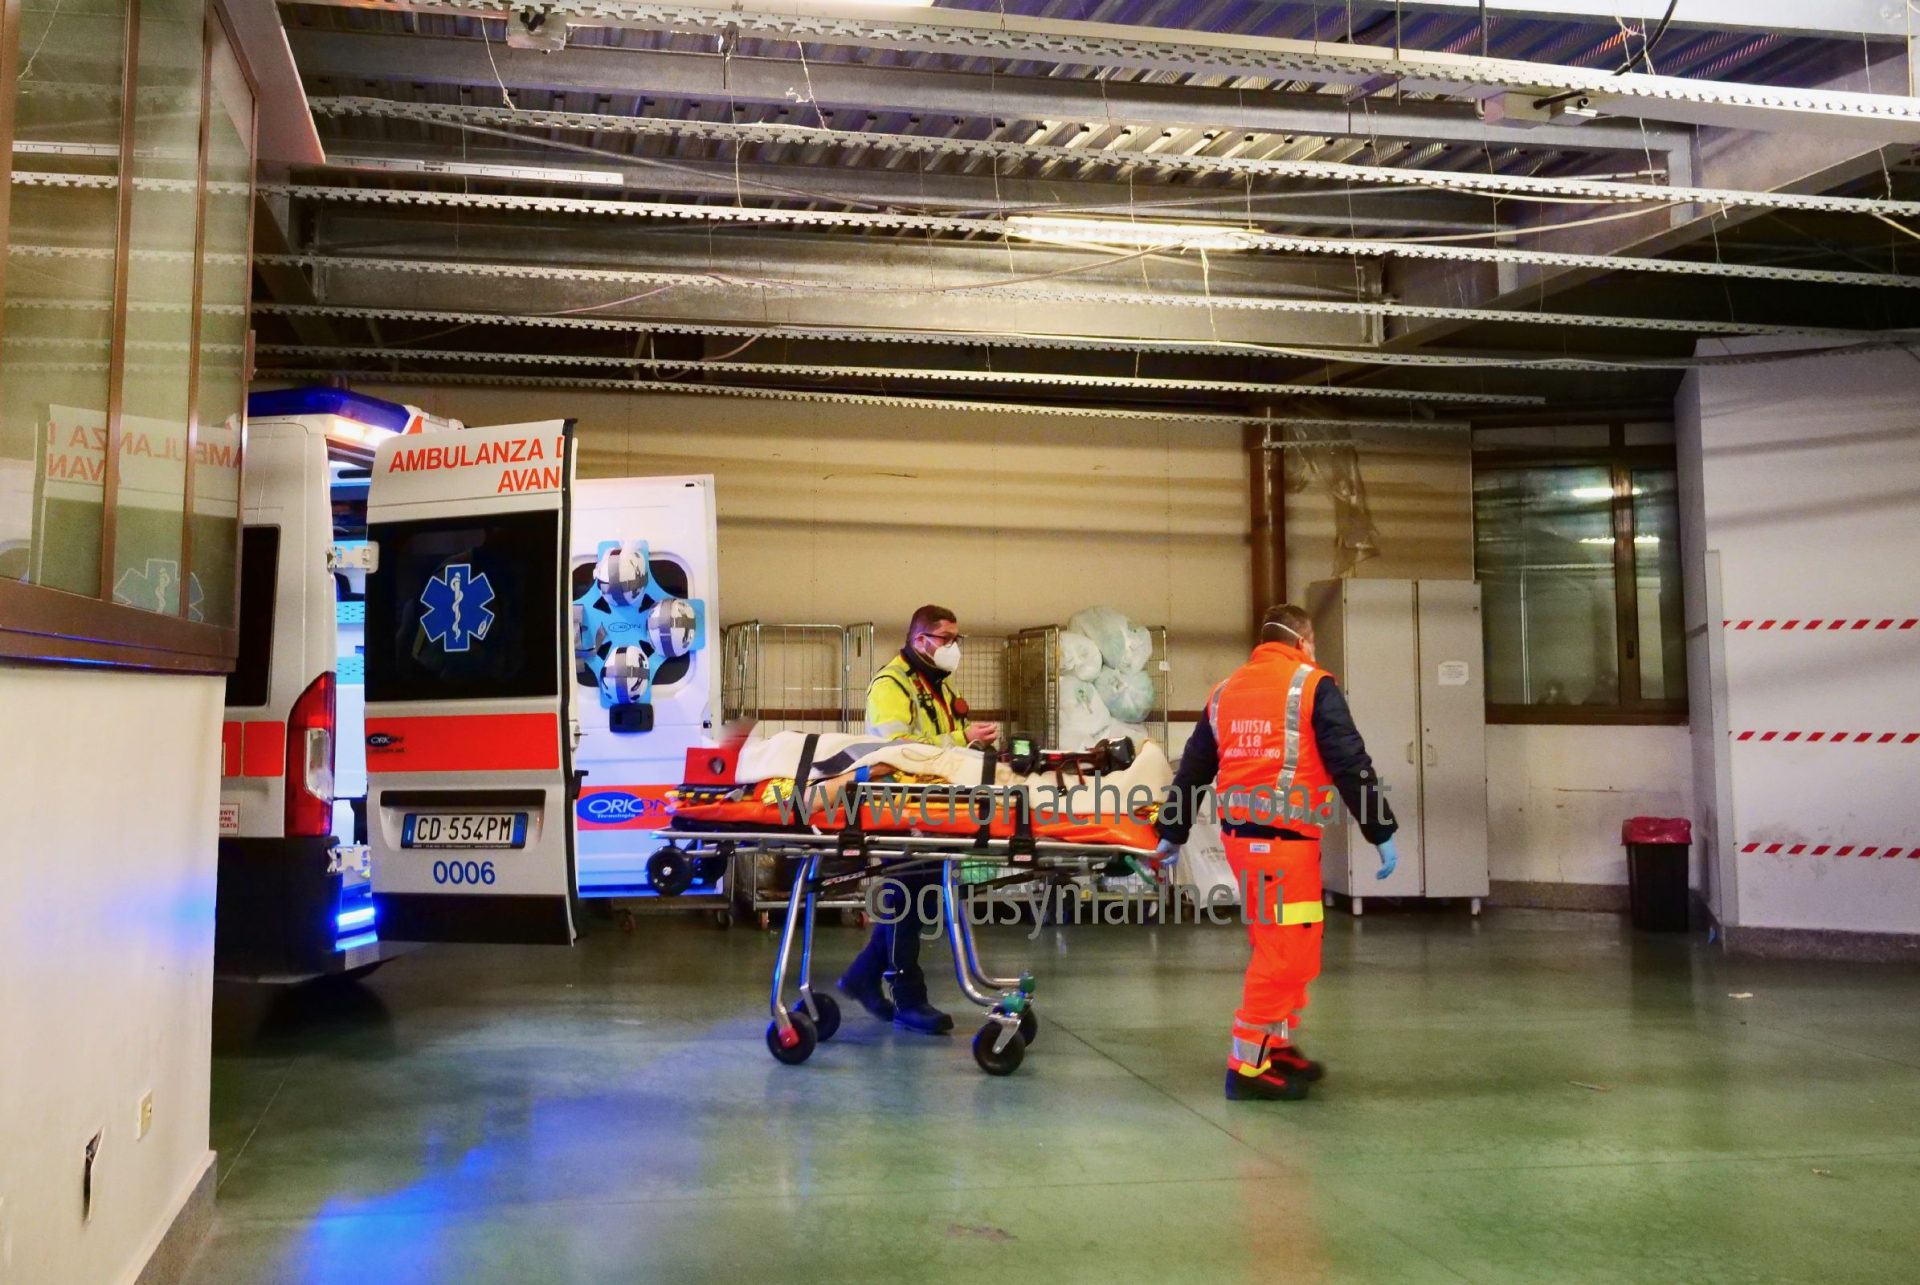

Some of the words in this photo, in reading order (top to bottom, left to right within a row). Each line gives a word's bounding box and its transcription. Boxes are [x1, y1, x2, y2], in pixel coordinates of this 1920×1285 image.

[389, 438, 544, 473] AMBULANZA
[497, 466, 560, 493] AVAN
[1231, 719, 1271, 735] AUTISTA
[433, 860, 496, 885] 0006
